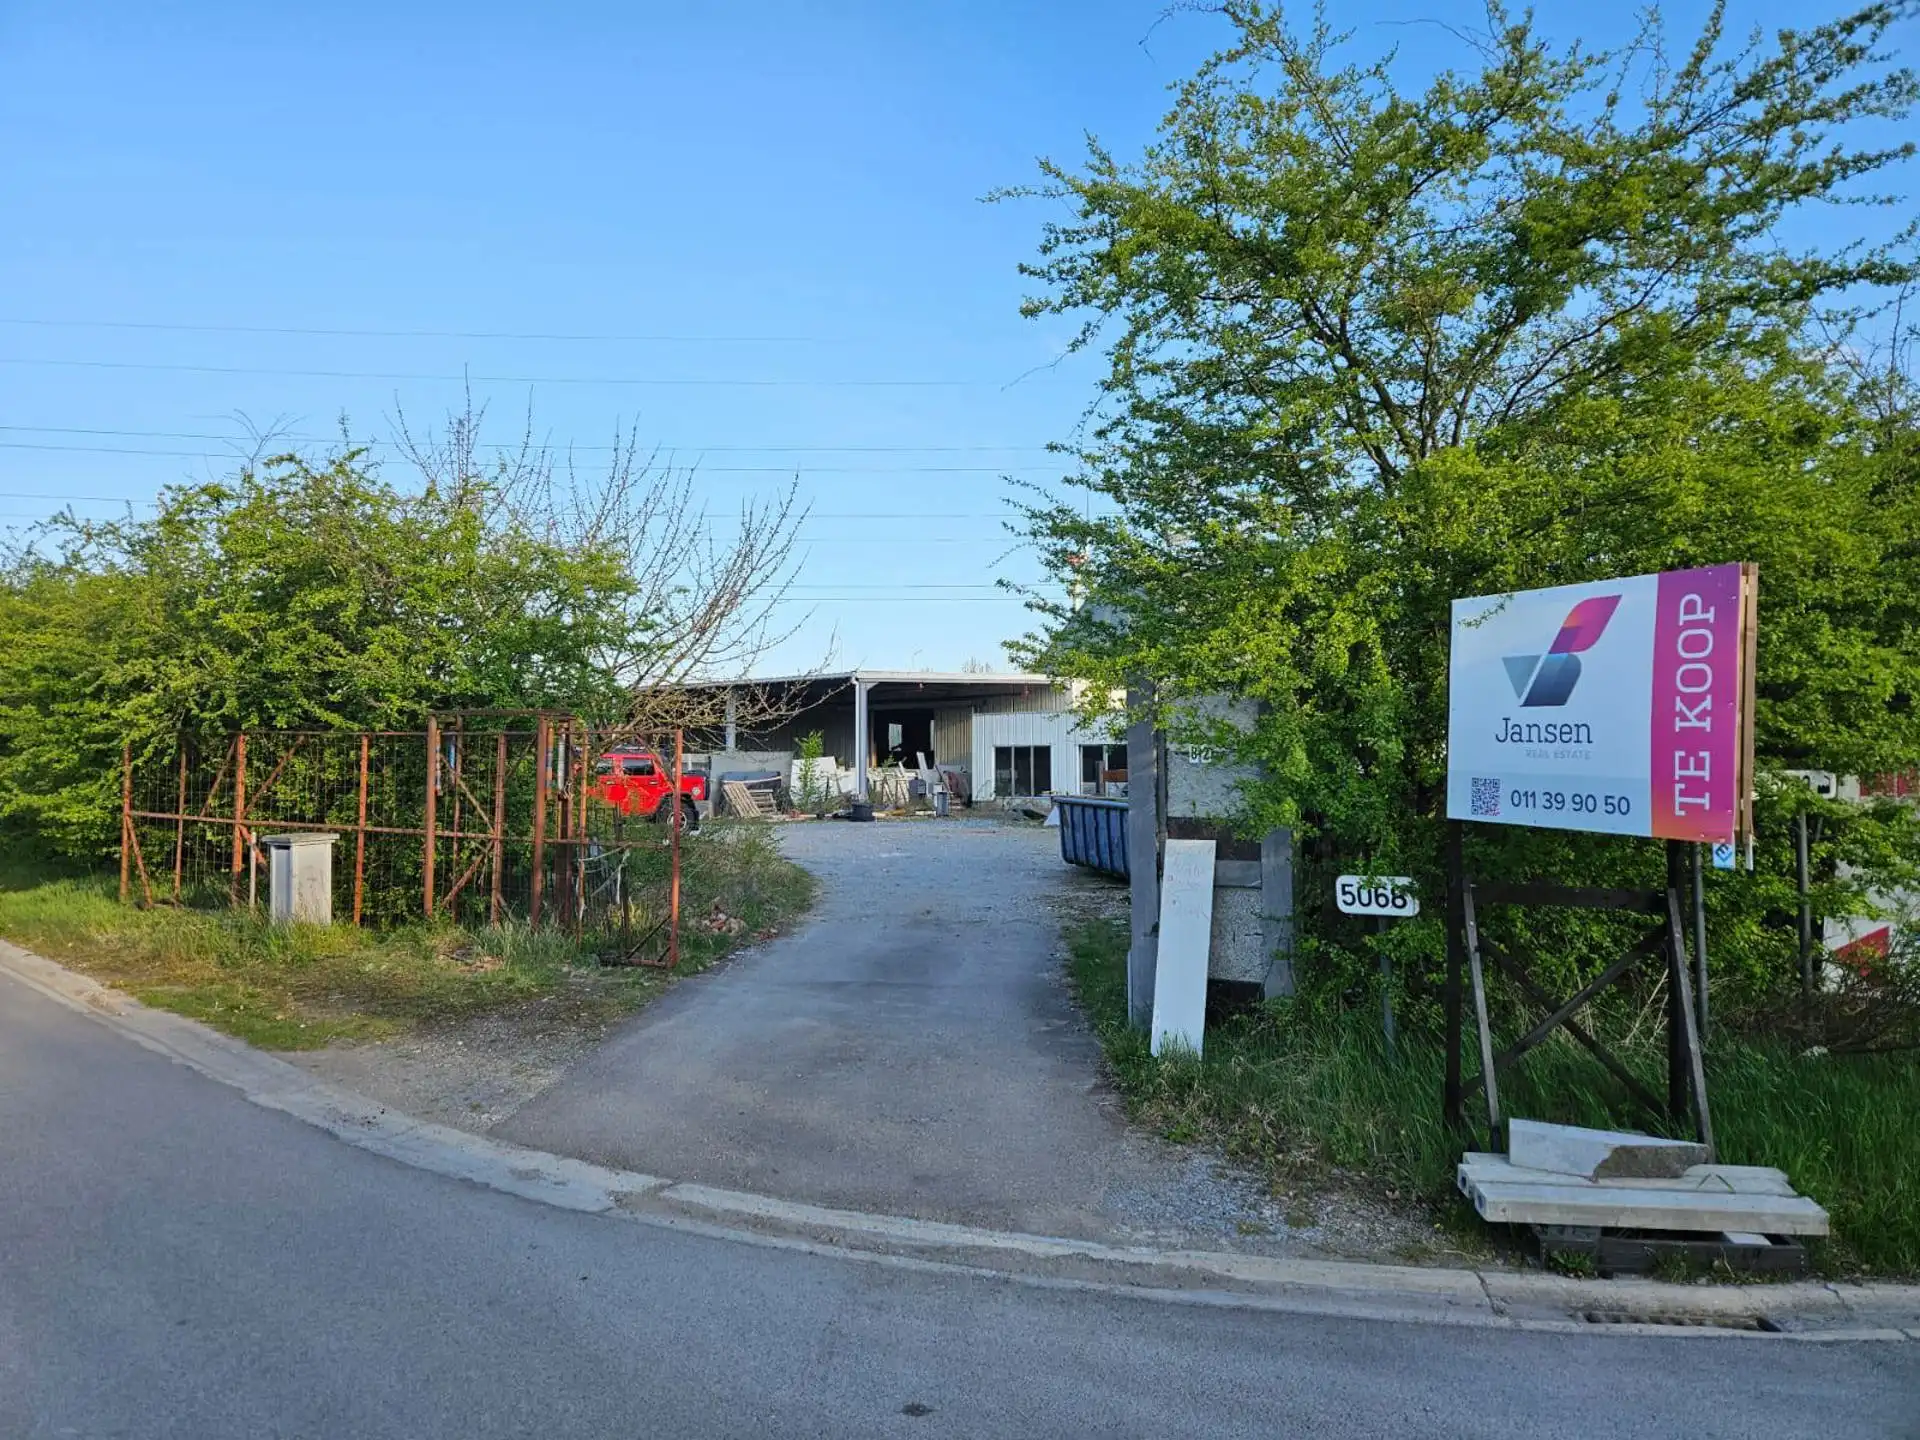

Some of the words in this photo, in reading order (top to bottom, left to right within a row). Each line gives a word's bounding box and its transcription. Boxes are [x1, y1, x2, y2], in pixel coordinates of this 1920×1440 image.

[1675, 593, 1715, 732] KOOP
[1495, 717, 1593, 744] Jansen
[1525, 748, 1550, 759] REAL
[1553, 749, 1592, 760] ESTATE
[1674, 750, 1710, 816] TE
[1510, 789, 1536, 809] 011
[1542, 791, 1565, 811] 39
[1571, 793, 1597, 813] 90
[1604, 795, 1630, 816] 50
